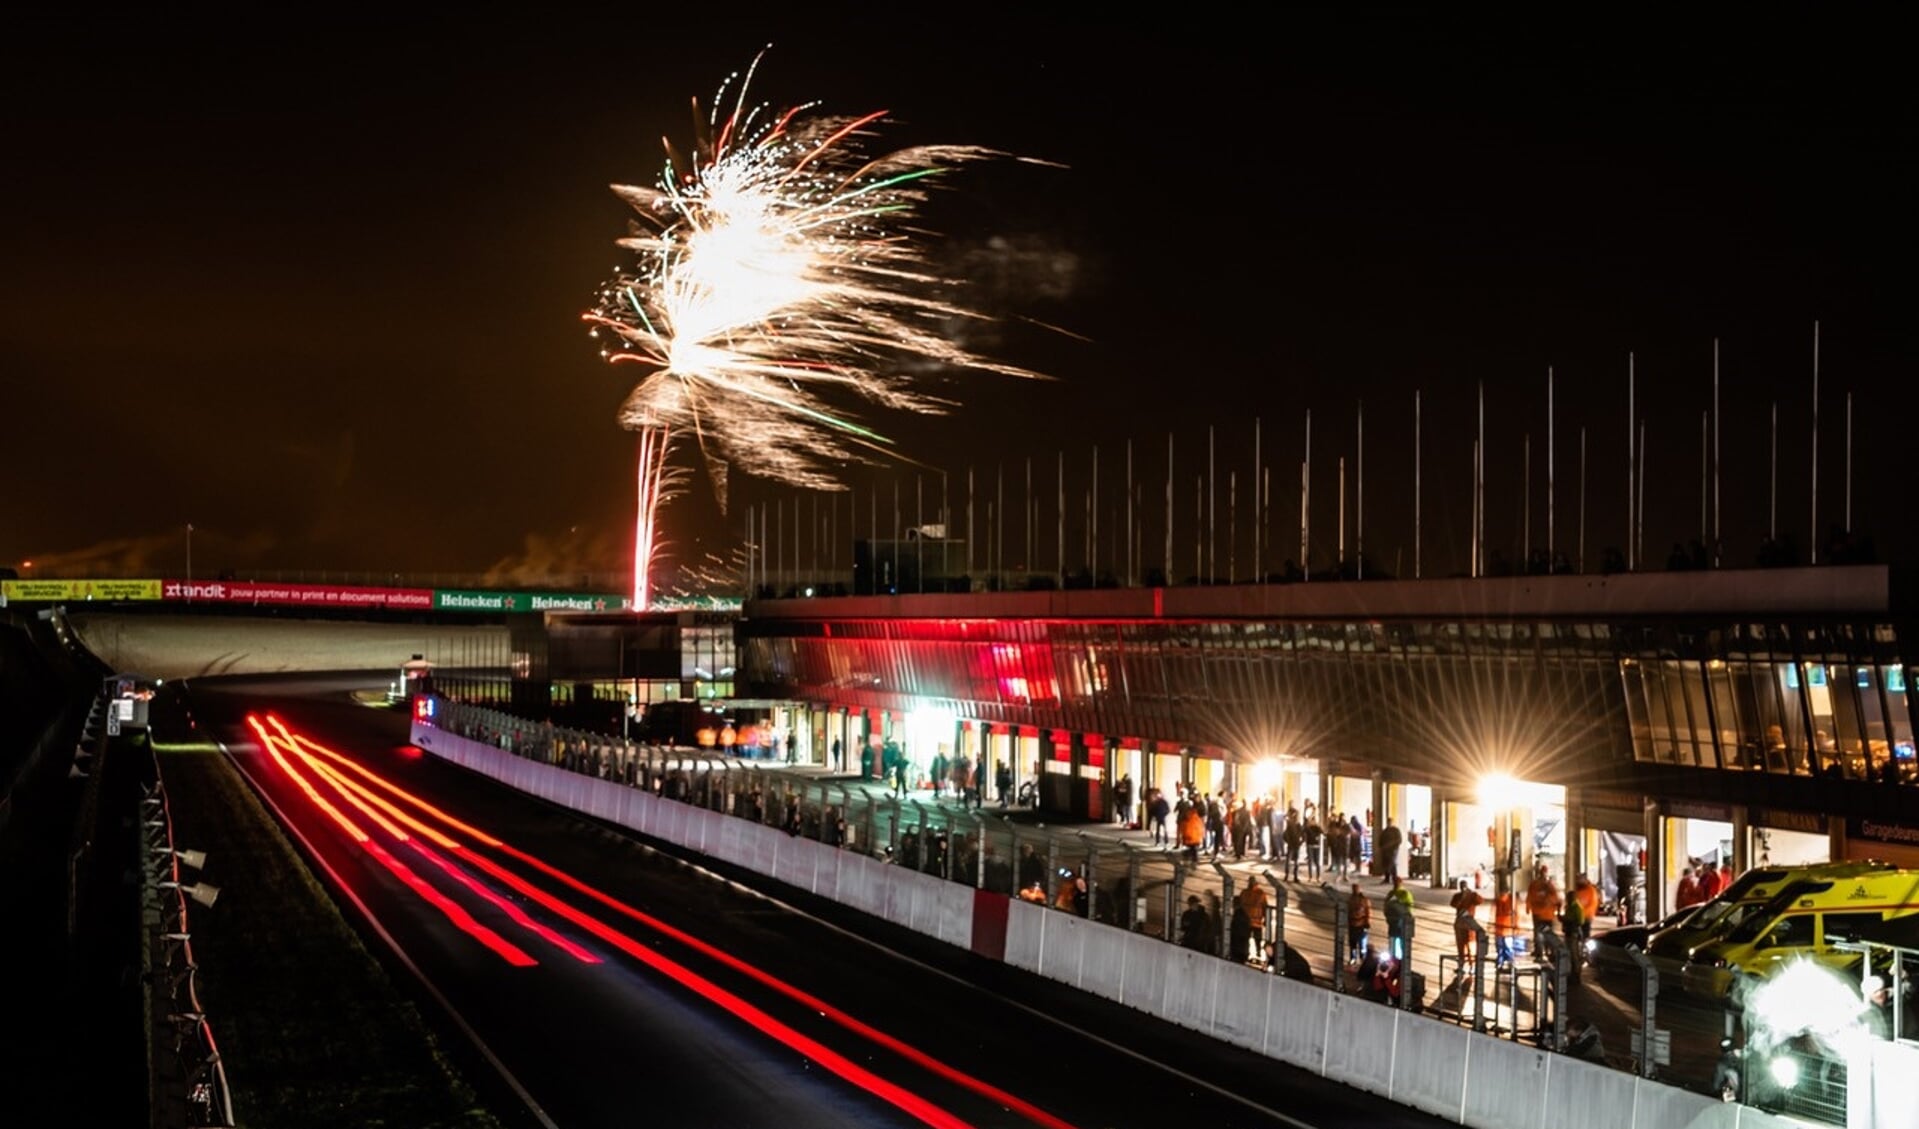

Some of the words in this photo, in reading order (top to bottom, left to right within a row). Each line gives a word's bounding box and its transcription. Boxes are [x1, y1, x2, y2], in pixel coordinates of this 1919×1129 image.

[255, 589, 289, 600] partner
[291, 590, 300, 599] in
[302, 591, 325, 601] print
[326, 592, 338, 600] en
[340, 591, 386, 603] document
[387, 593, 430, 605] solutions
[441, 594, 502, 608] Heineken
[531, 596, 592, 610] Heineken
